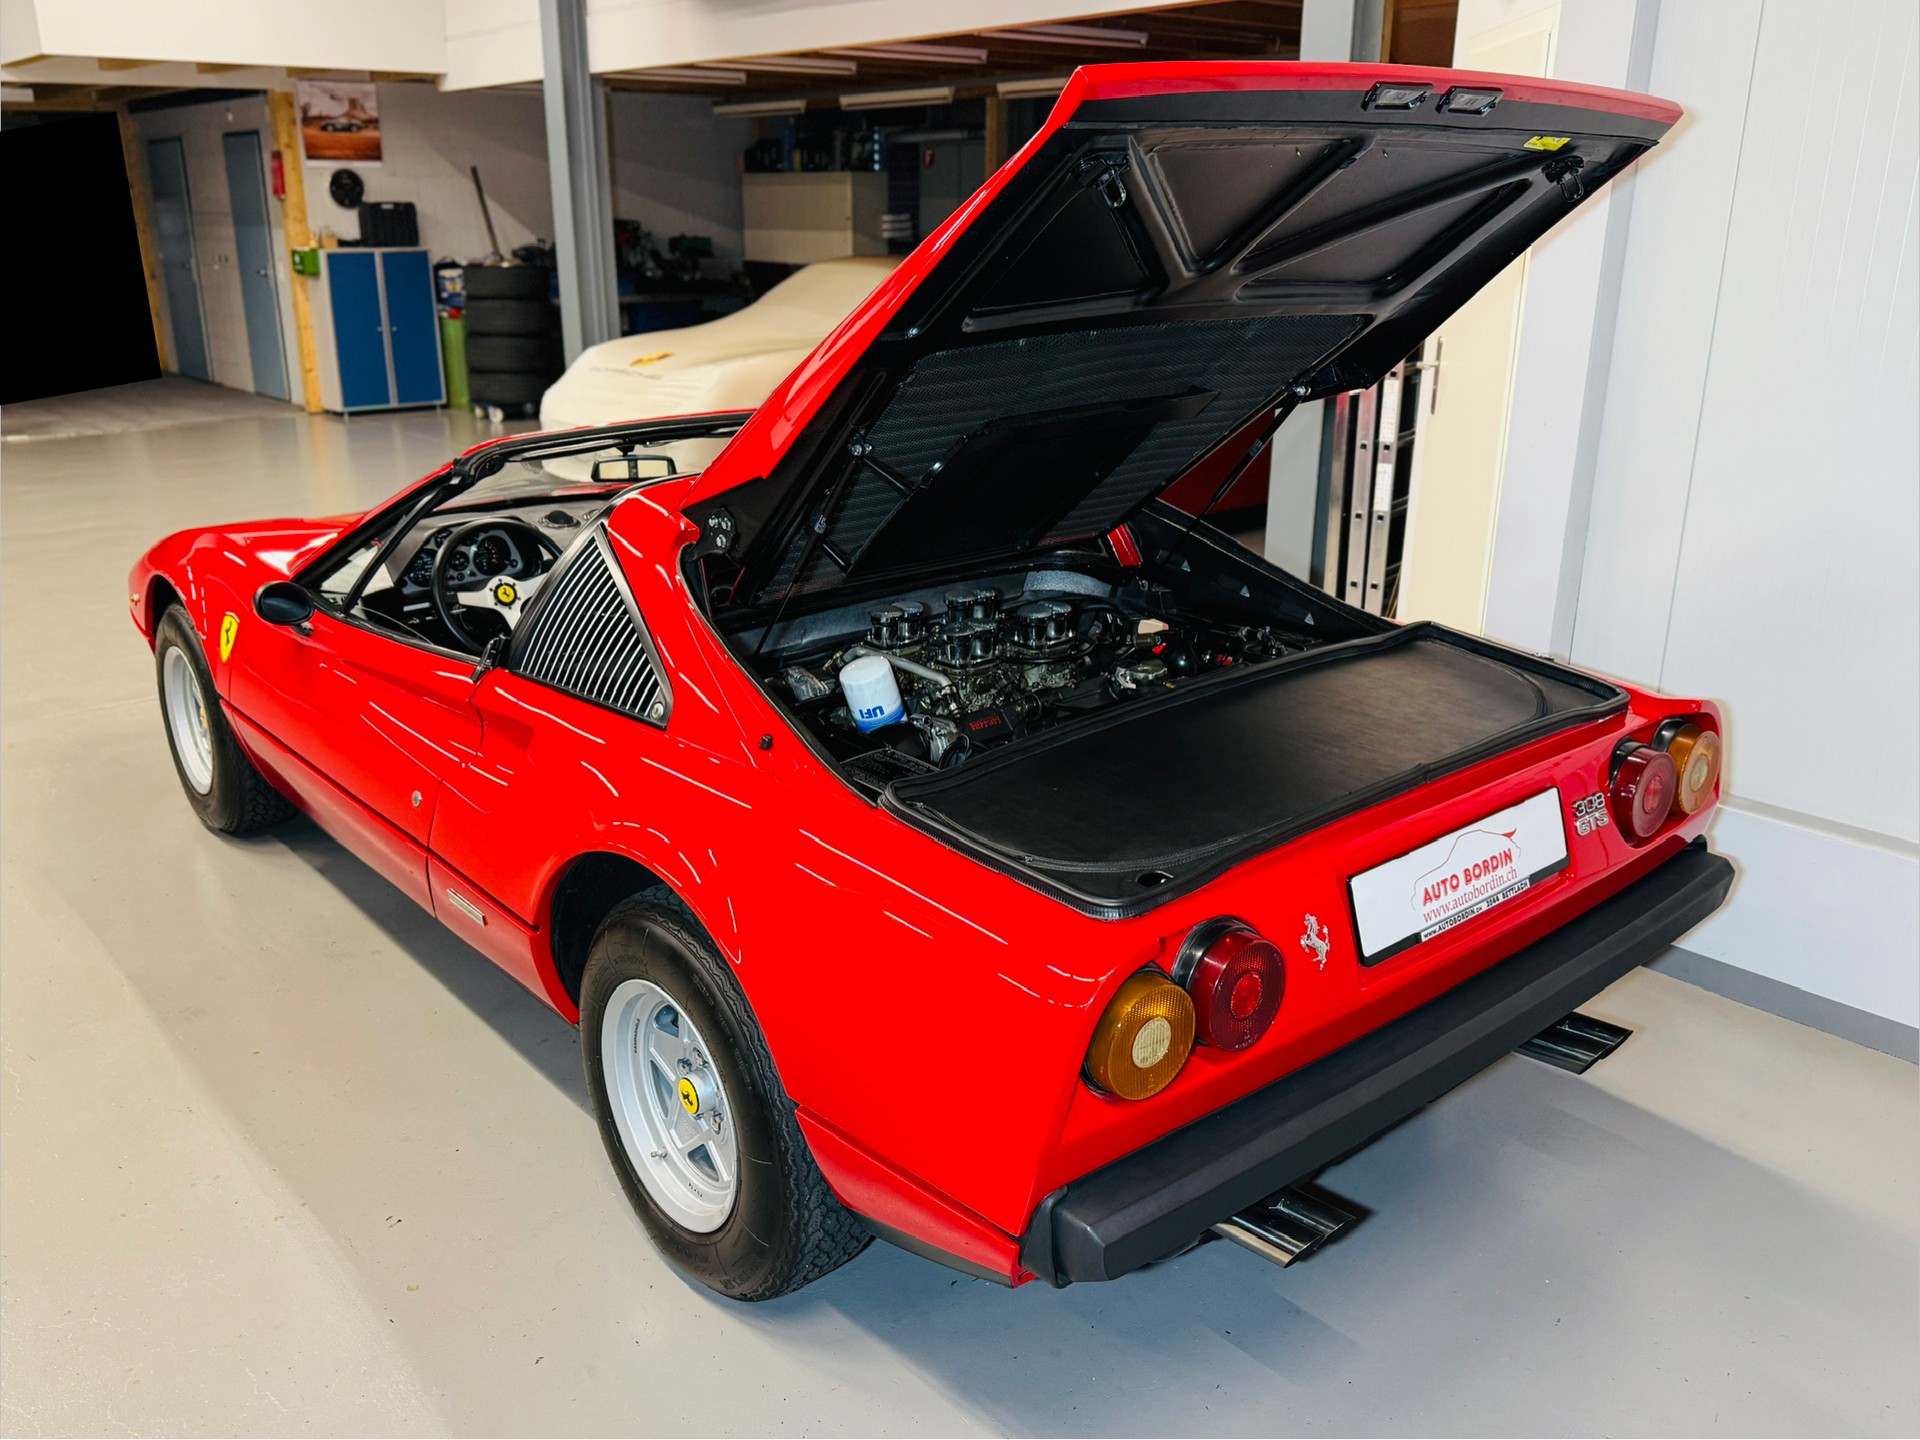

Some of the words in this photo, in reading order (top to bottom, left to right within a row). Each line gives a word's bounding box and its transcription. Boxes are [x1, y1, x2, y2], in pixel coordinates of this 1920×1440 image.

[858, 705, 885, 720] UFI
[1573, 792, 1606, 817] 308
[1576, 808, 1609, 836] GTS
[1423, 873, 1460, 907] AUTO
[1463, 847, 1513, 885] BORDIN
[1423, 866, 1518, 923] www.autobordin.ch
